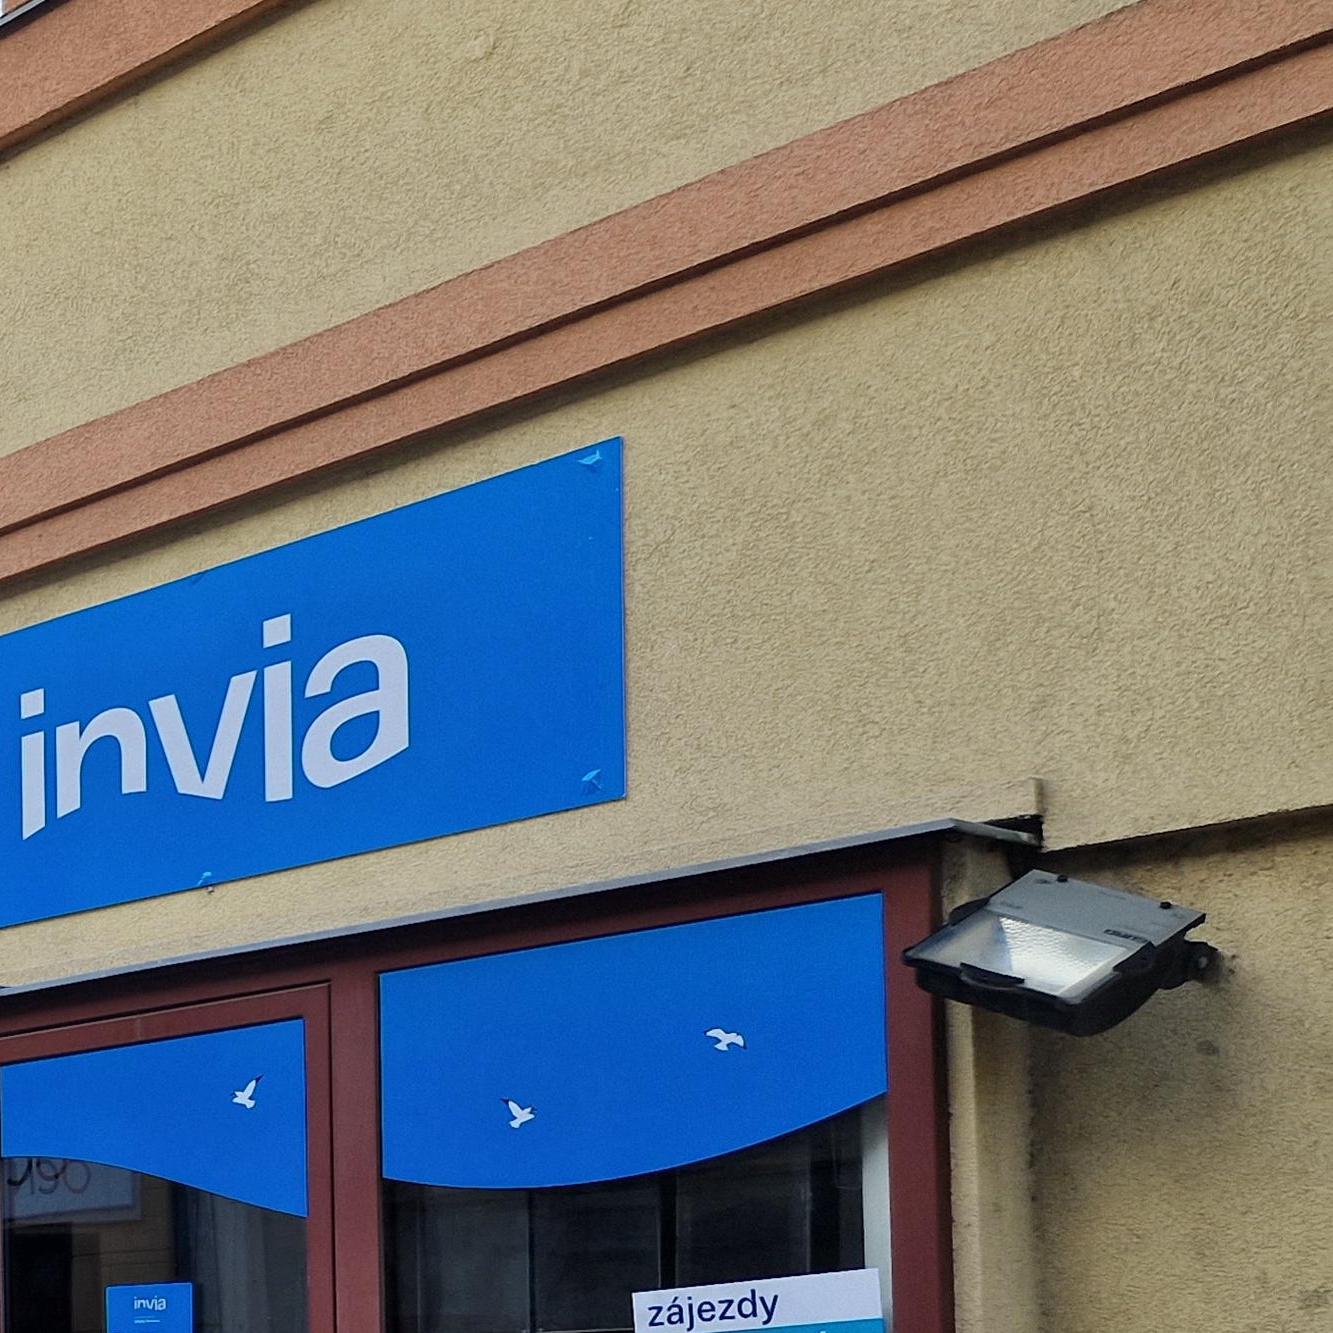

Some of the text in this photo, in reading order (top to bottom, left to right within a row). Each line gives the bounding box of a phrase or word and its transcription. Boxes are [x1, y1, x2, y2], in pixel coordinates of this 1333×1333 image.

[21, 613, 410, 840] invia
[133, 1295, 167, 1311] invia
[647, 1289, 780, 1332] zájezdy
